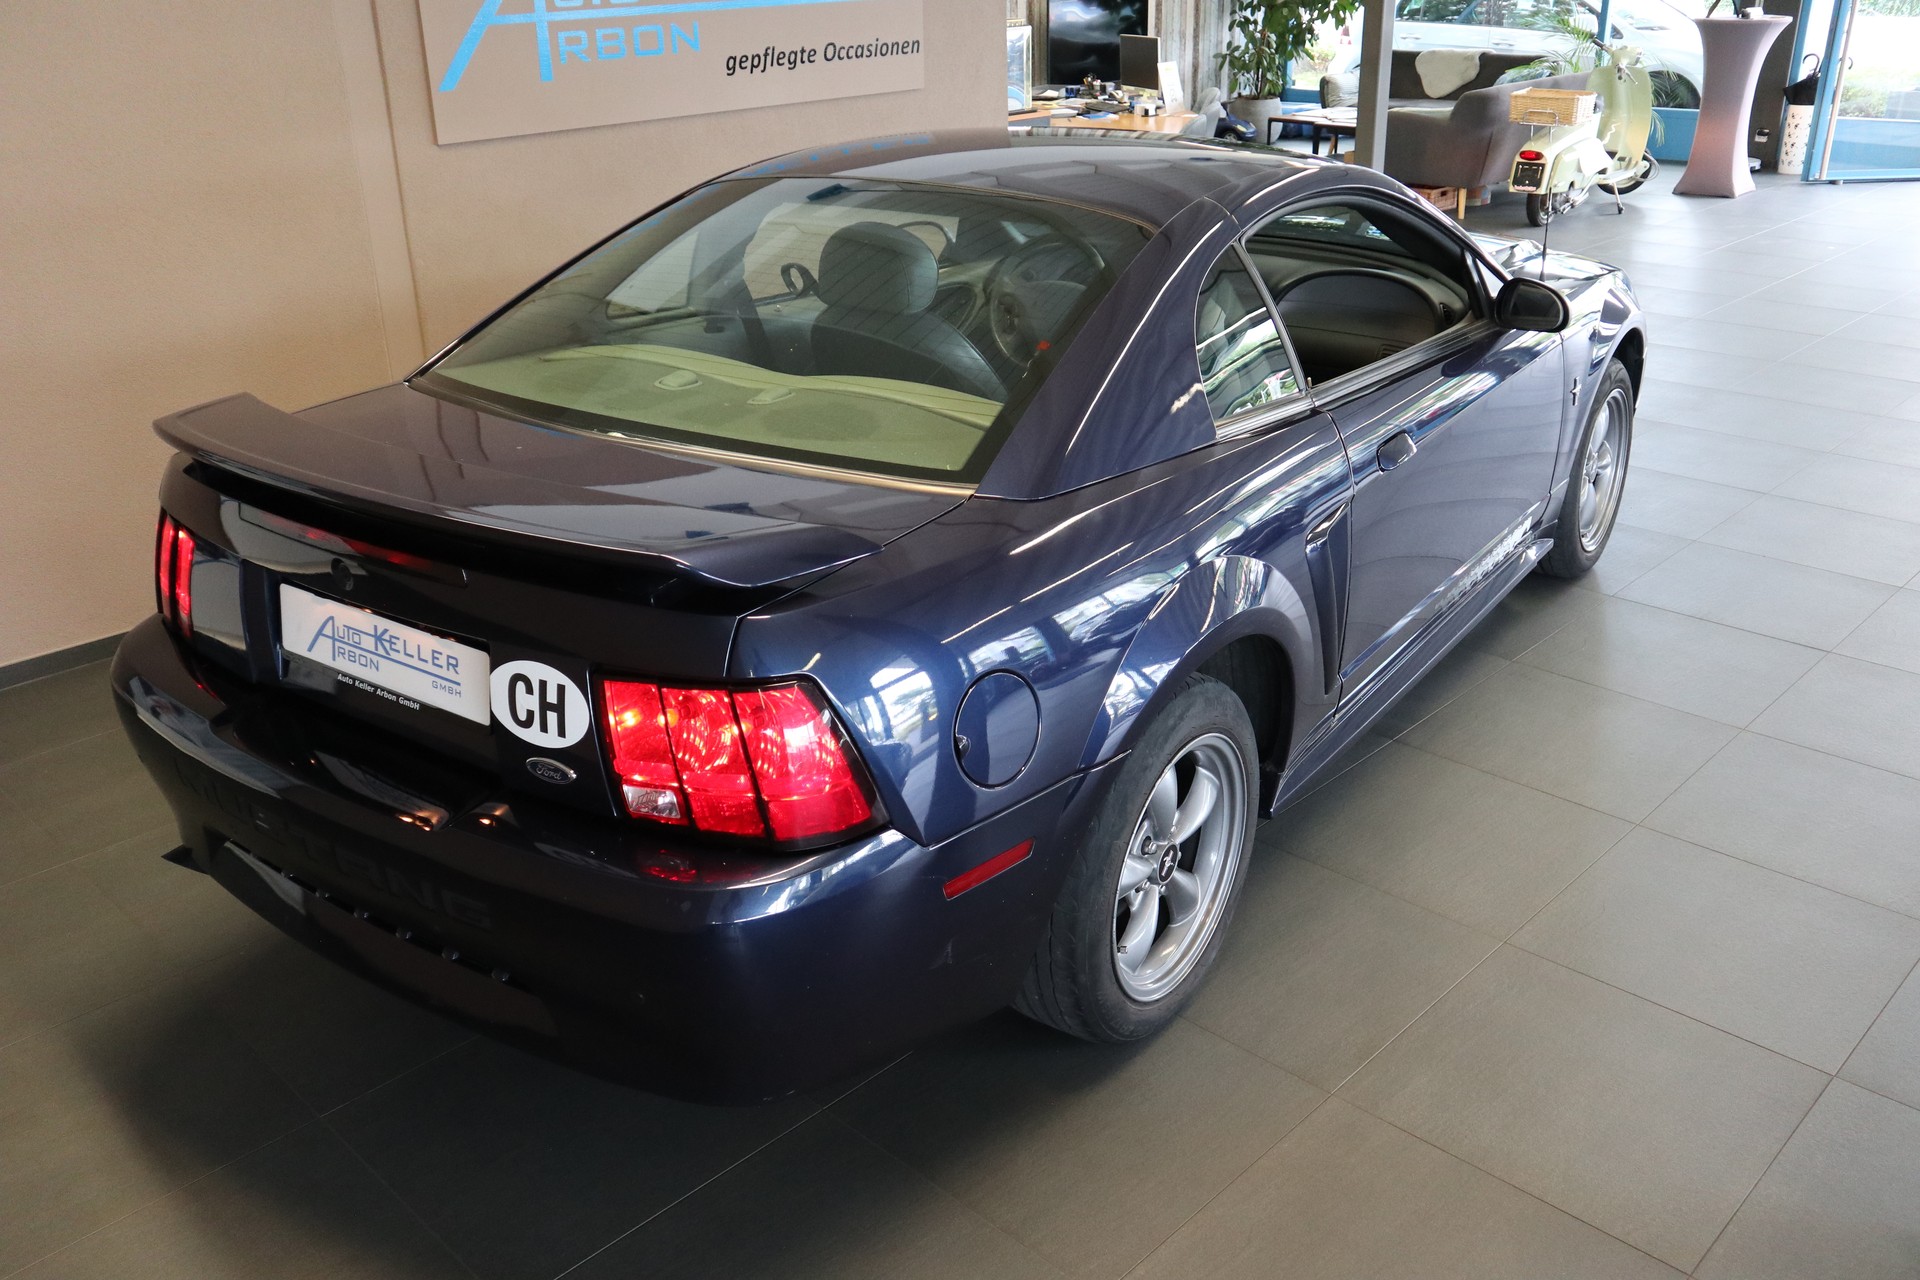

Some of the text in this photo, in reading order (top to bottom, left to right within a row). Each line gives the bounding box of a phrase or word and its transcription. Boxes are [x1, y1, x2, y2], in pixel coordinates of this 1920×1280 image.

[725, 38, 921, 77] gepflegte Occasionen
[373, 624, 460, 675] KELLER
[337, 673, 421, 711] Auto Keller Arbon GmbH
[431, 680, 463, 699] GMBH
[507, 672, 566, 739] CH
[535, 762, 563, 781] Ford
